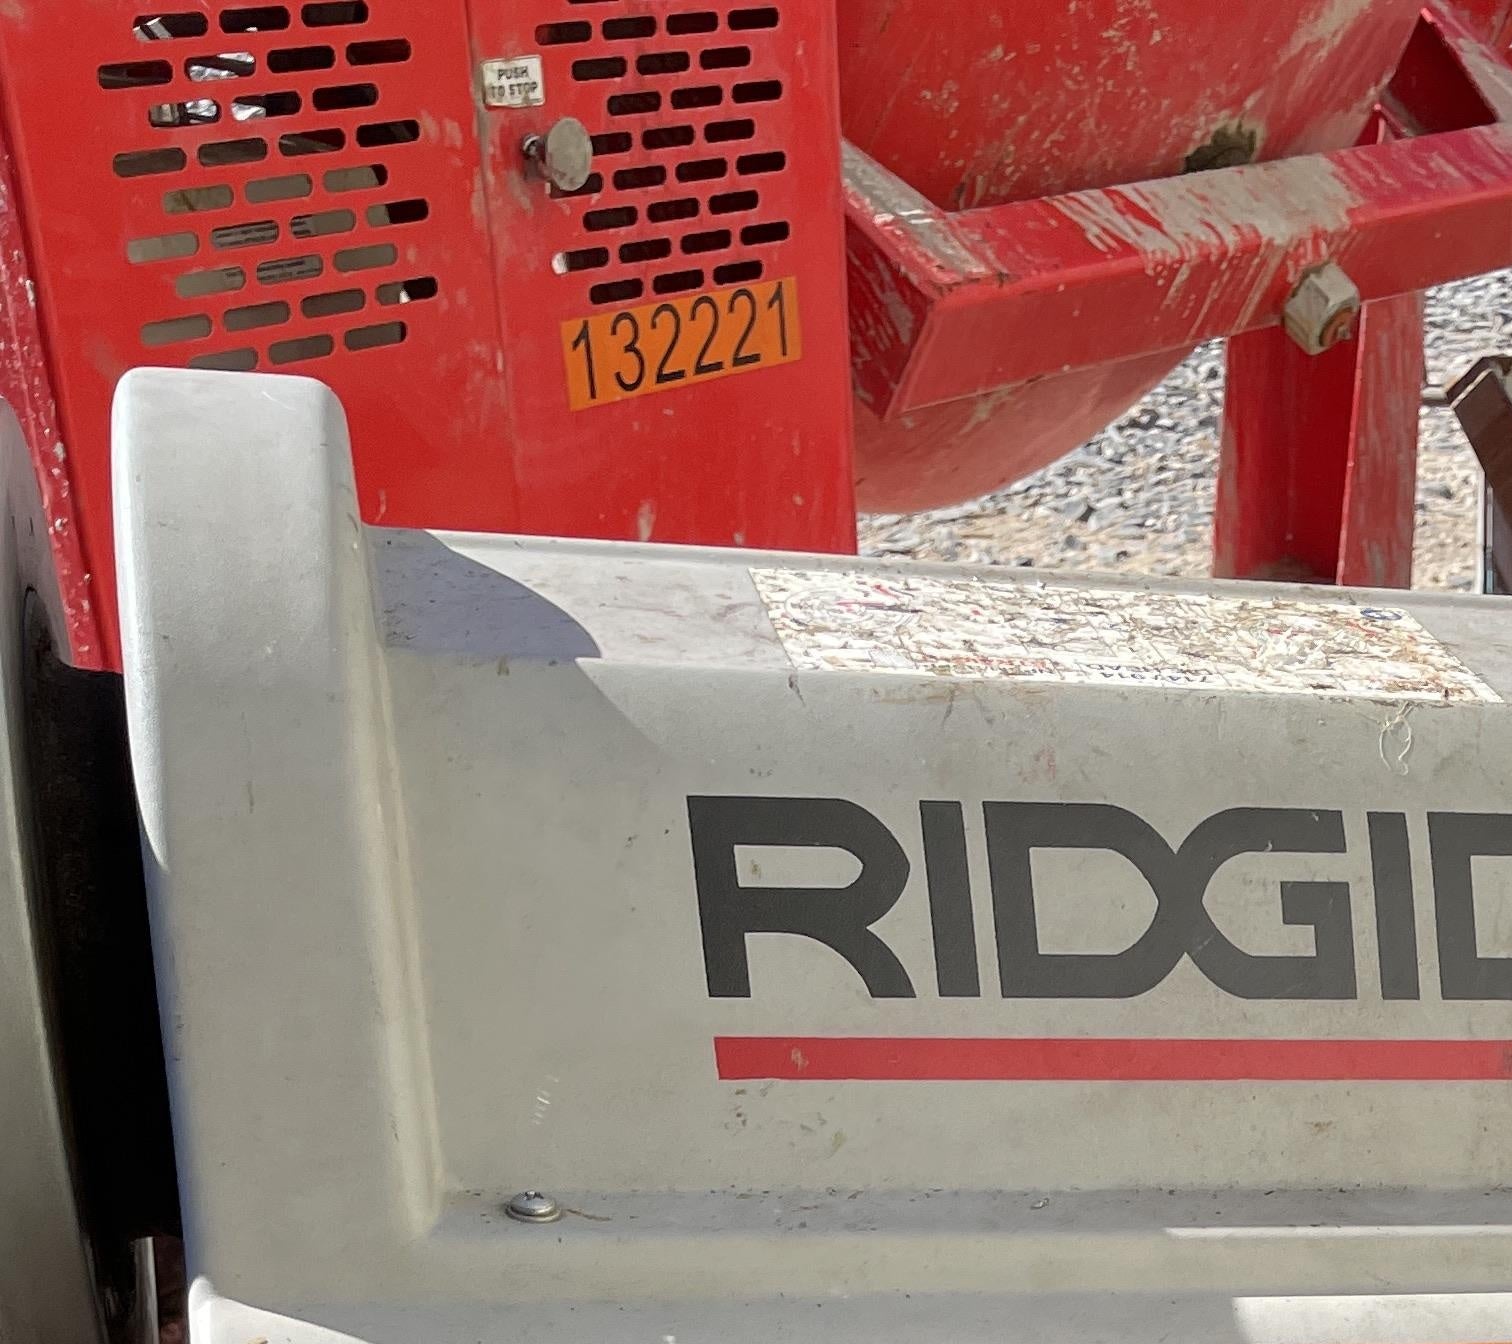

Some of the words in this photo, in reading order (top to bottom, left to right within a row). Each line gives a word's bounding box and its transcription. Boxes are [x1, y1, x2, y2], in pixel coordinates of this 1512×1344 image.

[497, 66, 529, 80] PUSH
[490, 85, 505, 98] TO
[509, 82, 537, 96] STOP
[572, 281, 787, 399] 132221
